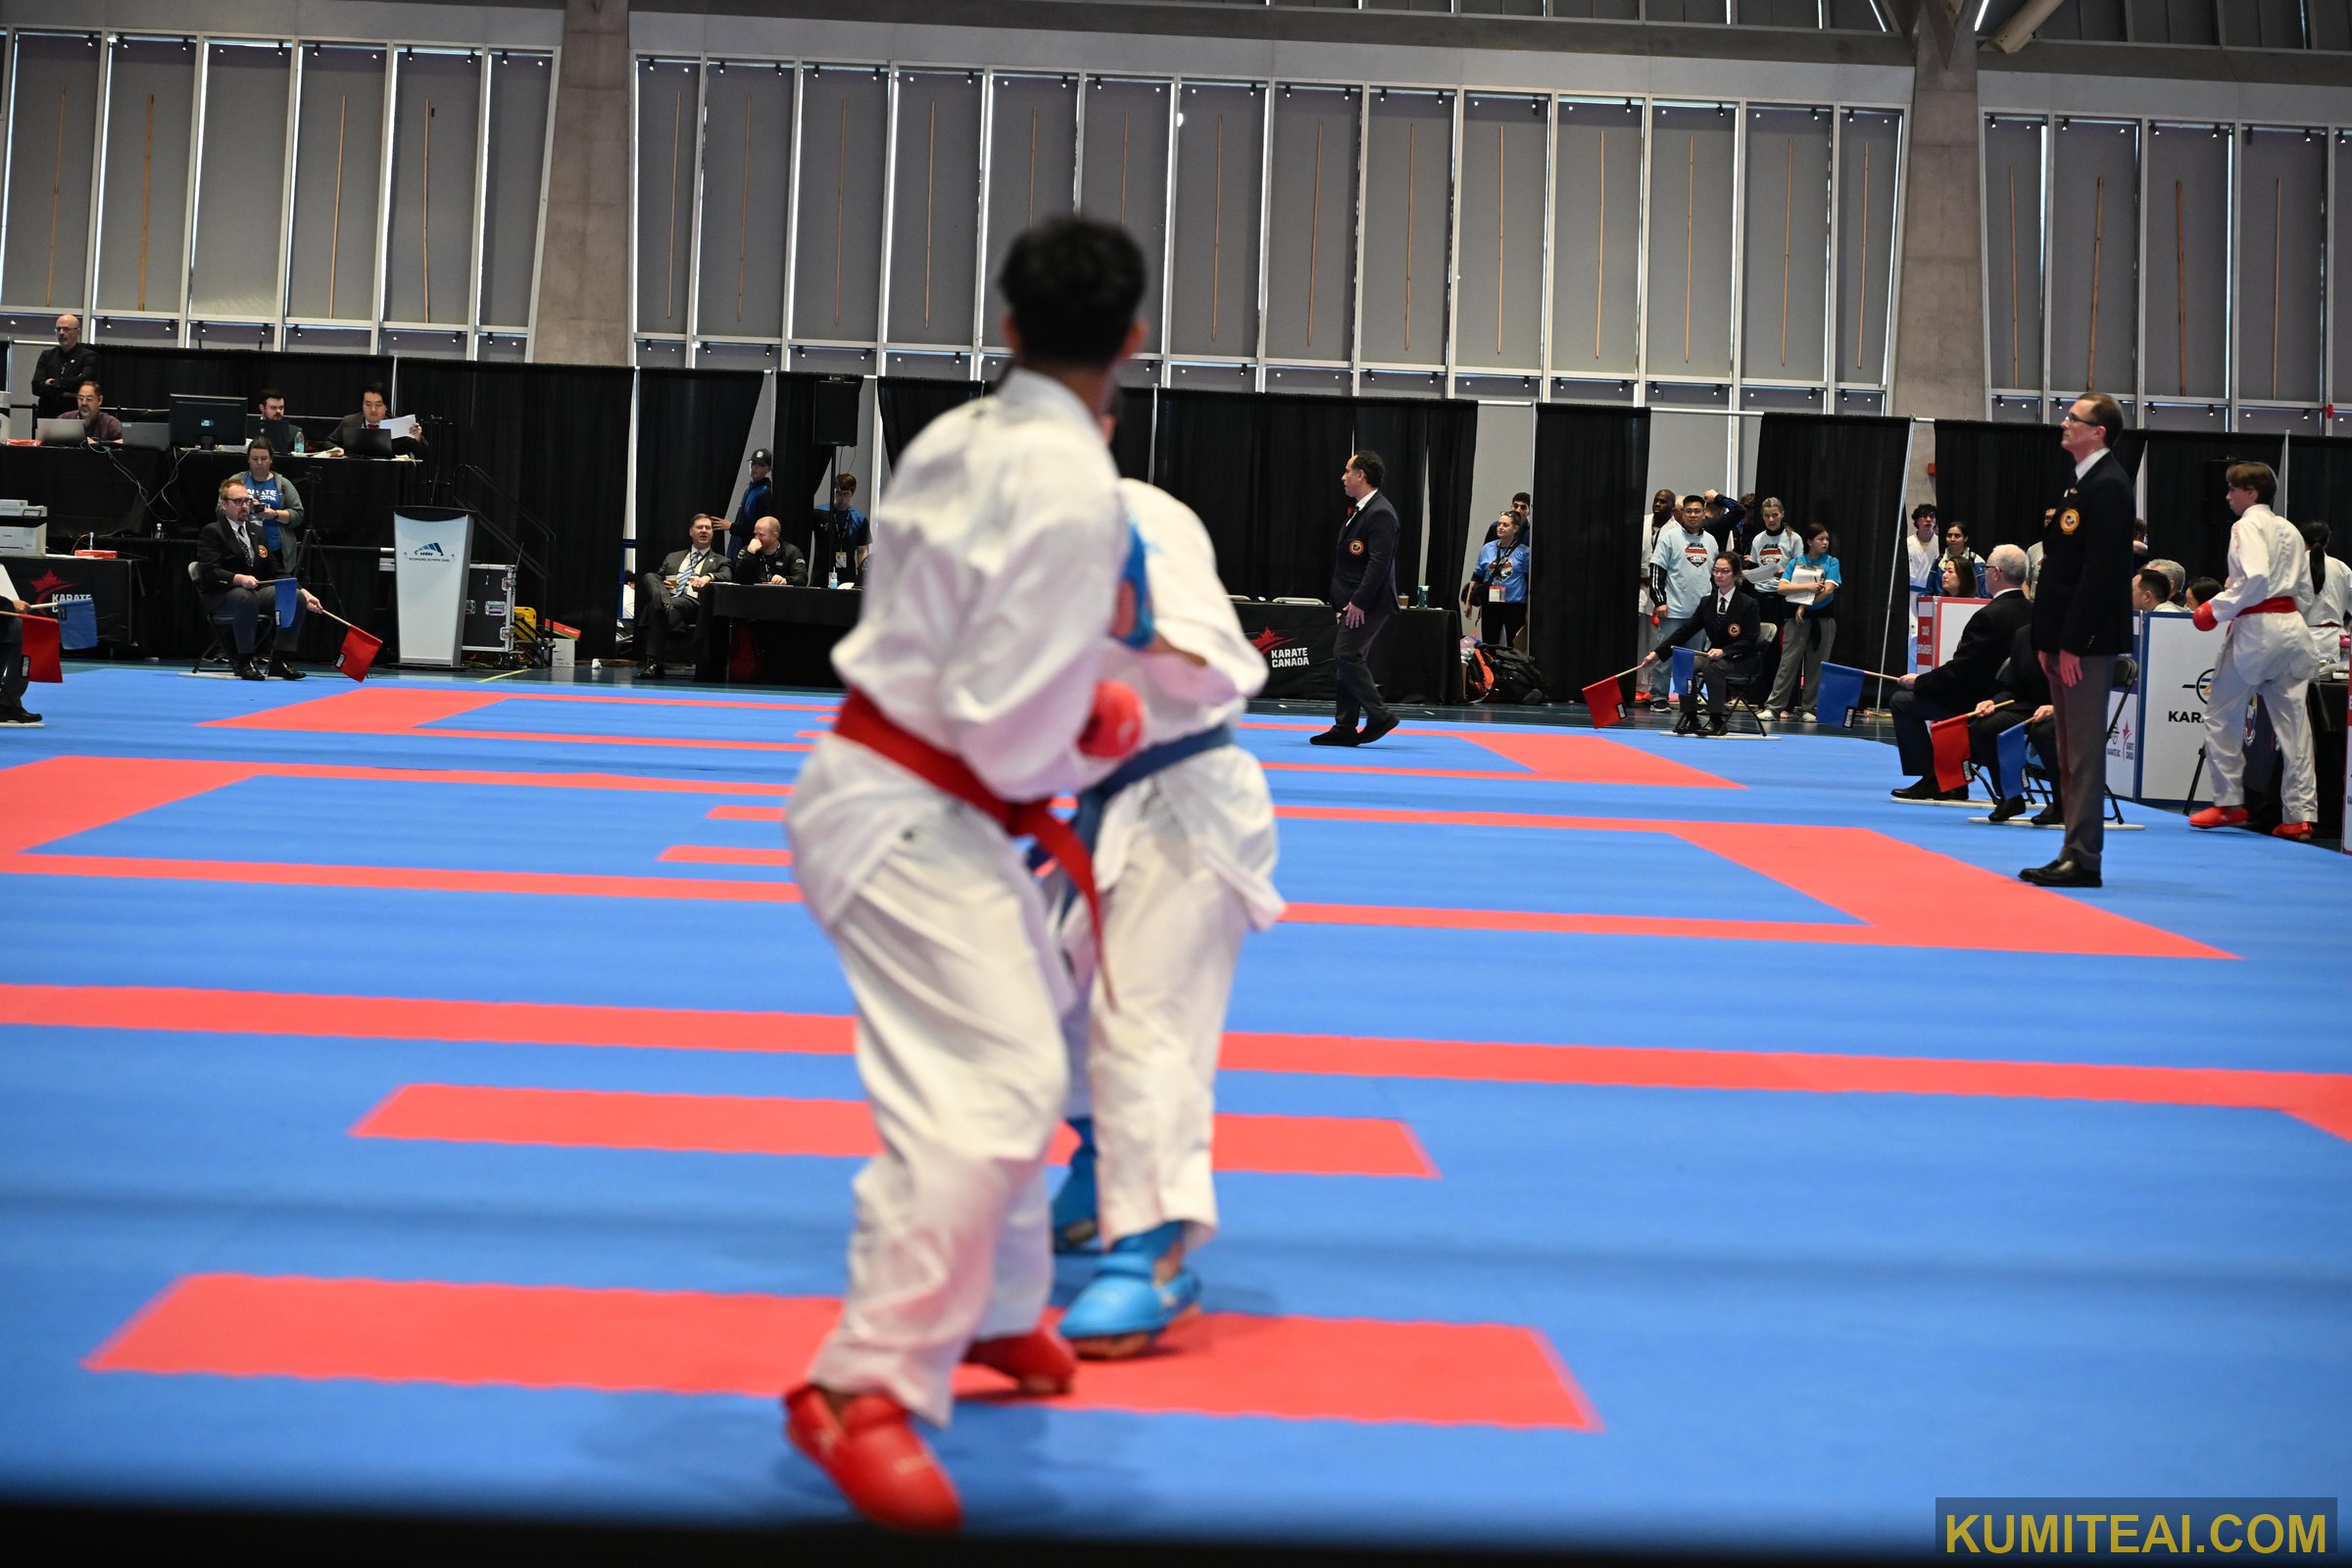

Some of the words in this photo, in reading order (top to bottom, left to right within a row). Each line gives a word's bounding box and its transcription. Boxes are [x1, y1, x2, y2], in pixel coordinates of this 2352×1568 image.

[1271, 647, 1308, 659] KARATE
[1271, 657, 1310, 668] CANADA
[2168, 710, 2204, 723] KAR
